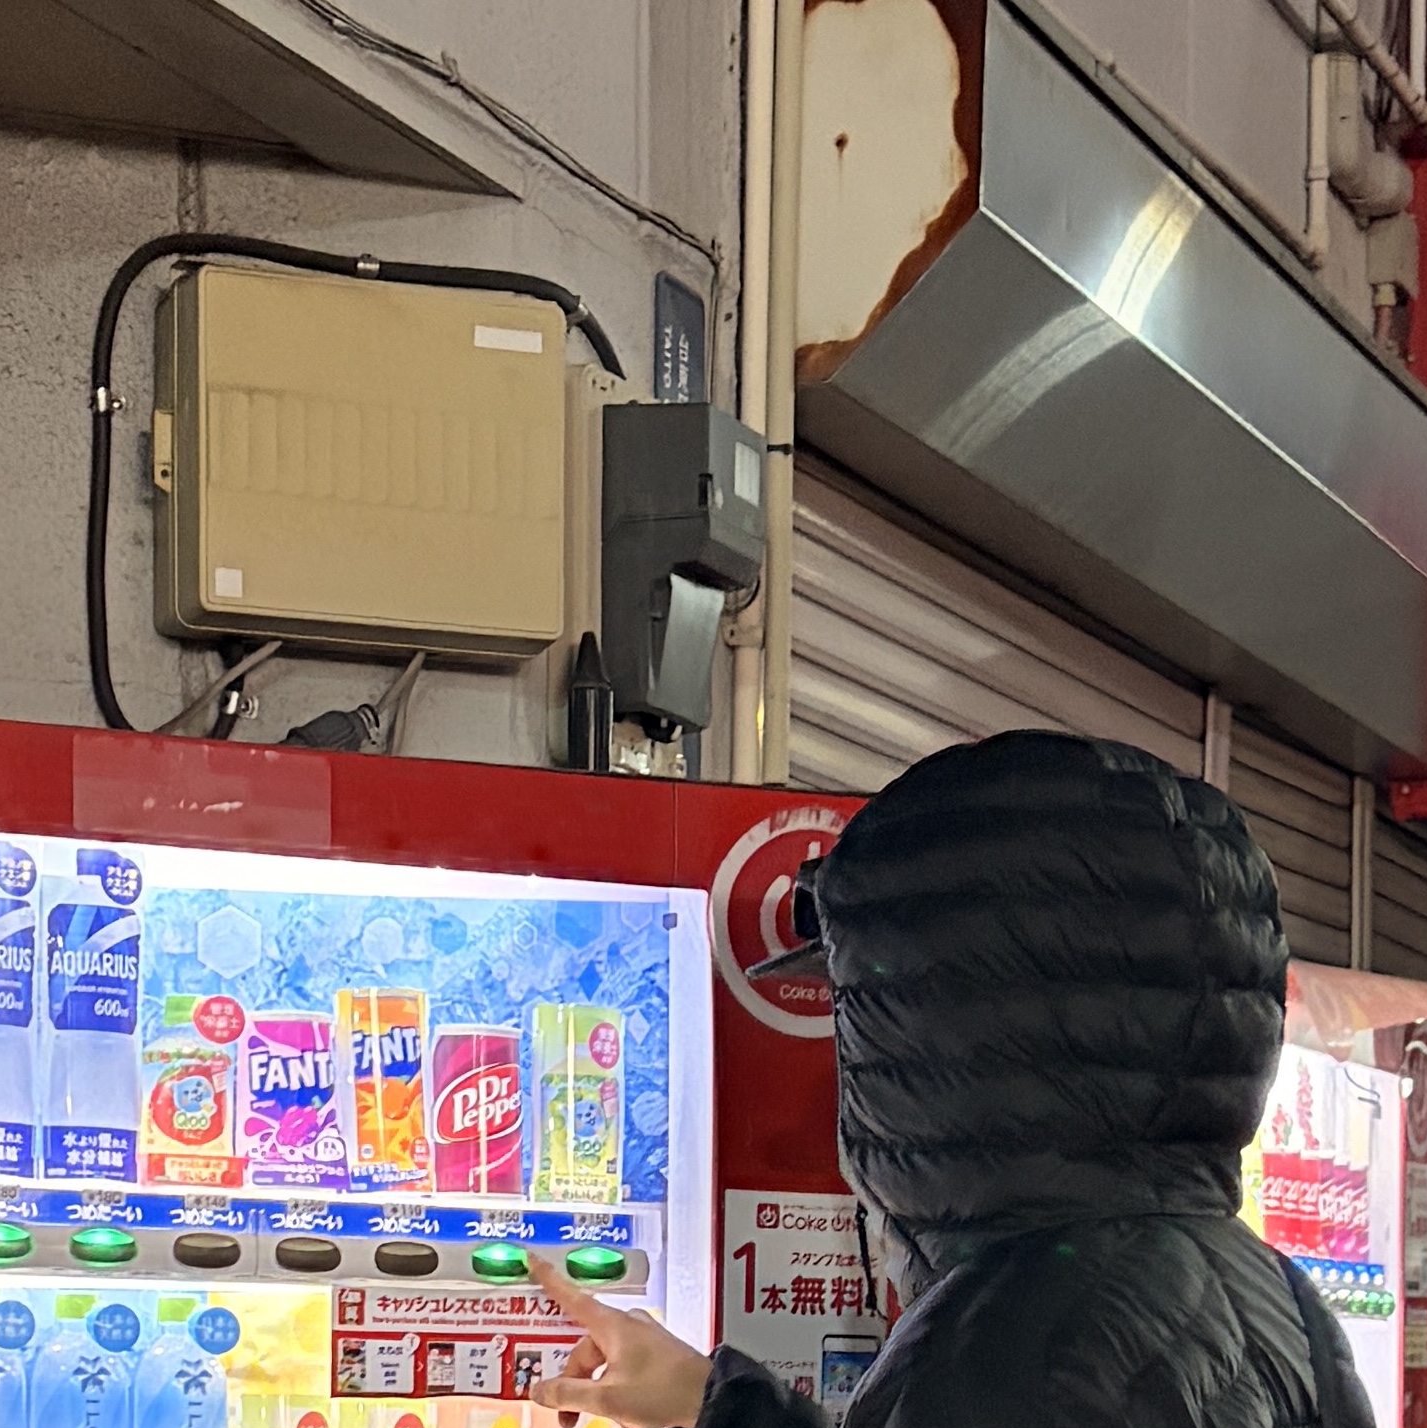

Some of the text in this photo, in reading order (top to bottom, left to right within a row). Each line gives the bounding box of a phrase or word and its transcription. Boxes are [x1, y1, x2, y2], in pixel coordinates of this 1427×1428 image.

[51, 951, 139, 980] AQUARIUS
[779, 984, 817, 1000] Coke
[477, 1075, 512, 1106] Dr
[175, 1112, 210, 1128] Qoo
[782, 1214, 827, 1232] Coke
[732, 1240, 878, 1317] 1本無料
[376, 1296, 567, 1317] キャッシュレスでのご購入方
